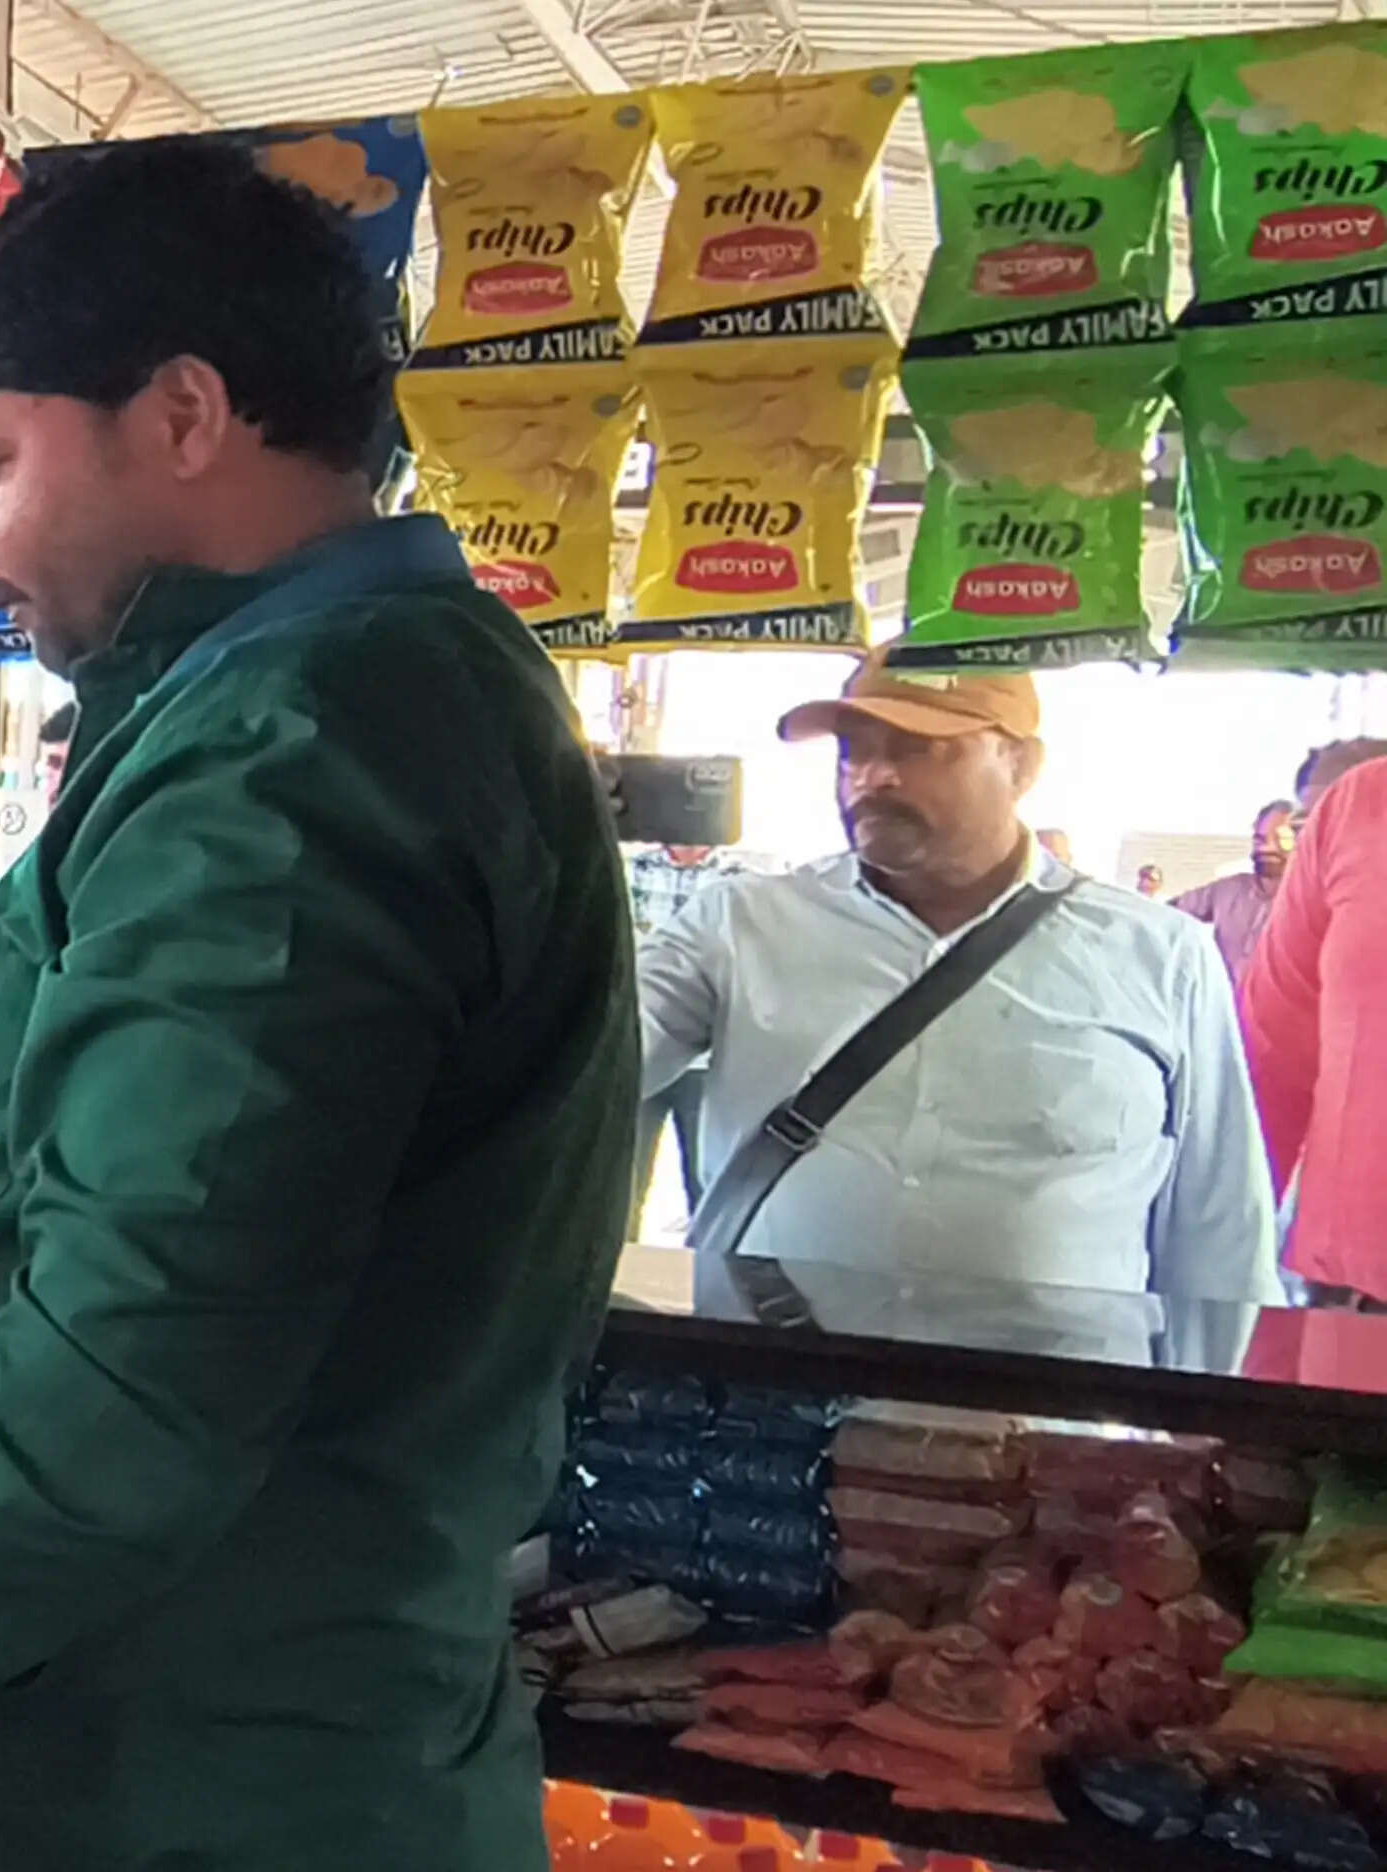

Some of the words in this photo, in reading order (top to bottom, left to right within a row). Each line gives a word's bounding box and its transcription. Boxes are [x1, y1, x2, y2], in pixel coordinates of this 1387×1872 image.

[1256, 159, 1387, 200] Chips
[704, 184, 822, 223] Chips
[973, 193, 1103, 235] Chips
[469, 218, 575, 257] Chips
[1264, 214, 1376, 245] Aakash
[711, 241, 808, 264] Aakash
[1250, 287, 1335, 319] PACK
[699, 308, 773, 337] PACK
[973, 324, 1050, 350] PACK
[1058, 301, 1166, 344] FAMILY
[466, 338, 533, 364] PACK
[683, 493, 803, 537] Chips
[1245, 486, 1385, 530] Chips
[959, 512, 1085, 558] Chips
[690, 555, 788, 579] Aakash
[1255, 548, 1370, 579] Aakash
[475, 572, 547, 594] Aakas
[965, 579, 1069, 600] Aakash
[679, 623, 750, 641] PACK
[954, 645, 1031, 662] PACK
[1041, 635, 1140, 665] FAILY
